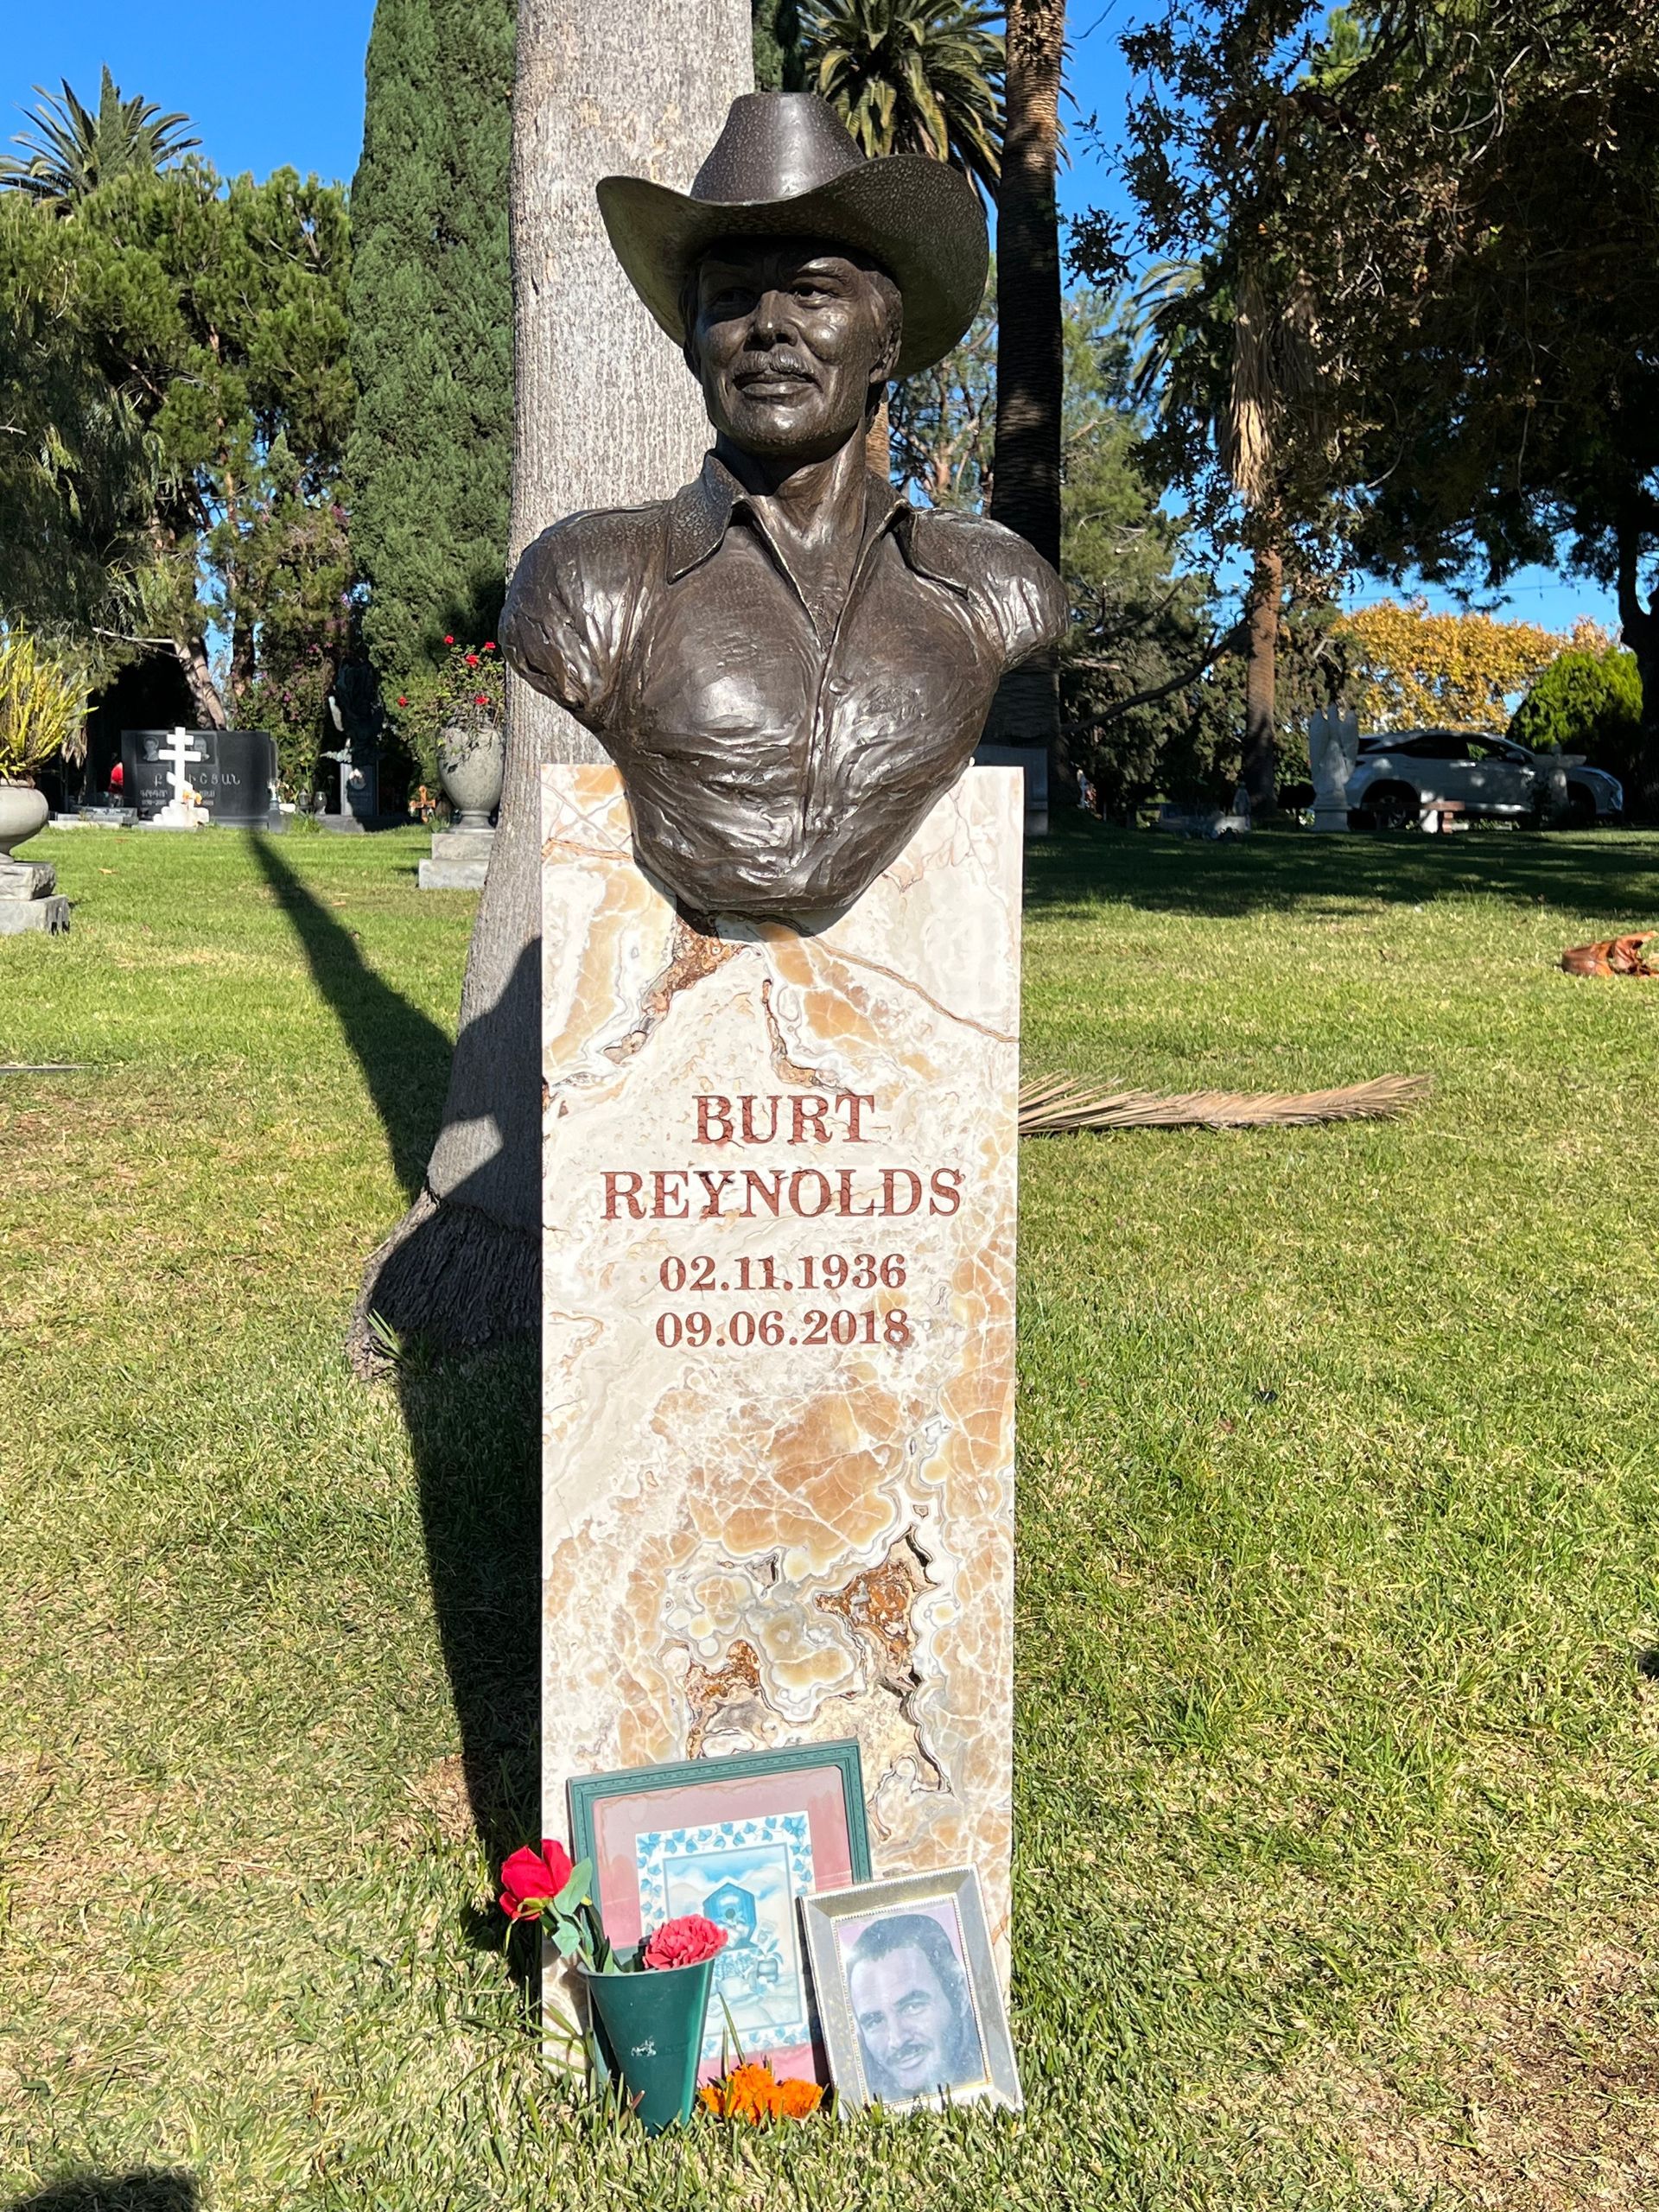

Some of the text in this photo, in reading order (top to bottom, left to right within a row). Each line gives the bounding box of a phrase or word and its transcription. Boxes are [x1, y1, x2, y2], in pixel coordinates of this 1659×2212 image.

[692, 1095, 874, 1144] BURT
[600, 1169, 963, 1219] REYNOLDS
[659, 1254, 906, 1292] 02.11.1936
[655, 1309, 910, 1348] 09.06.2018
